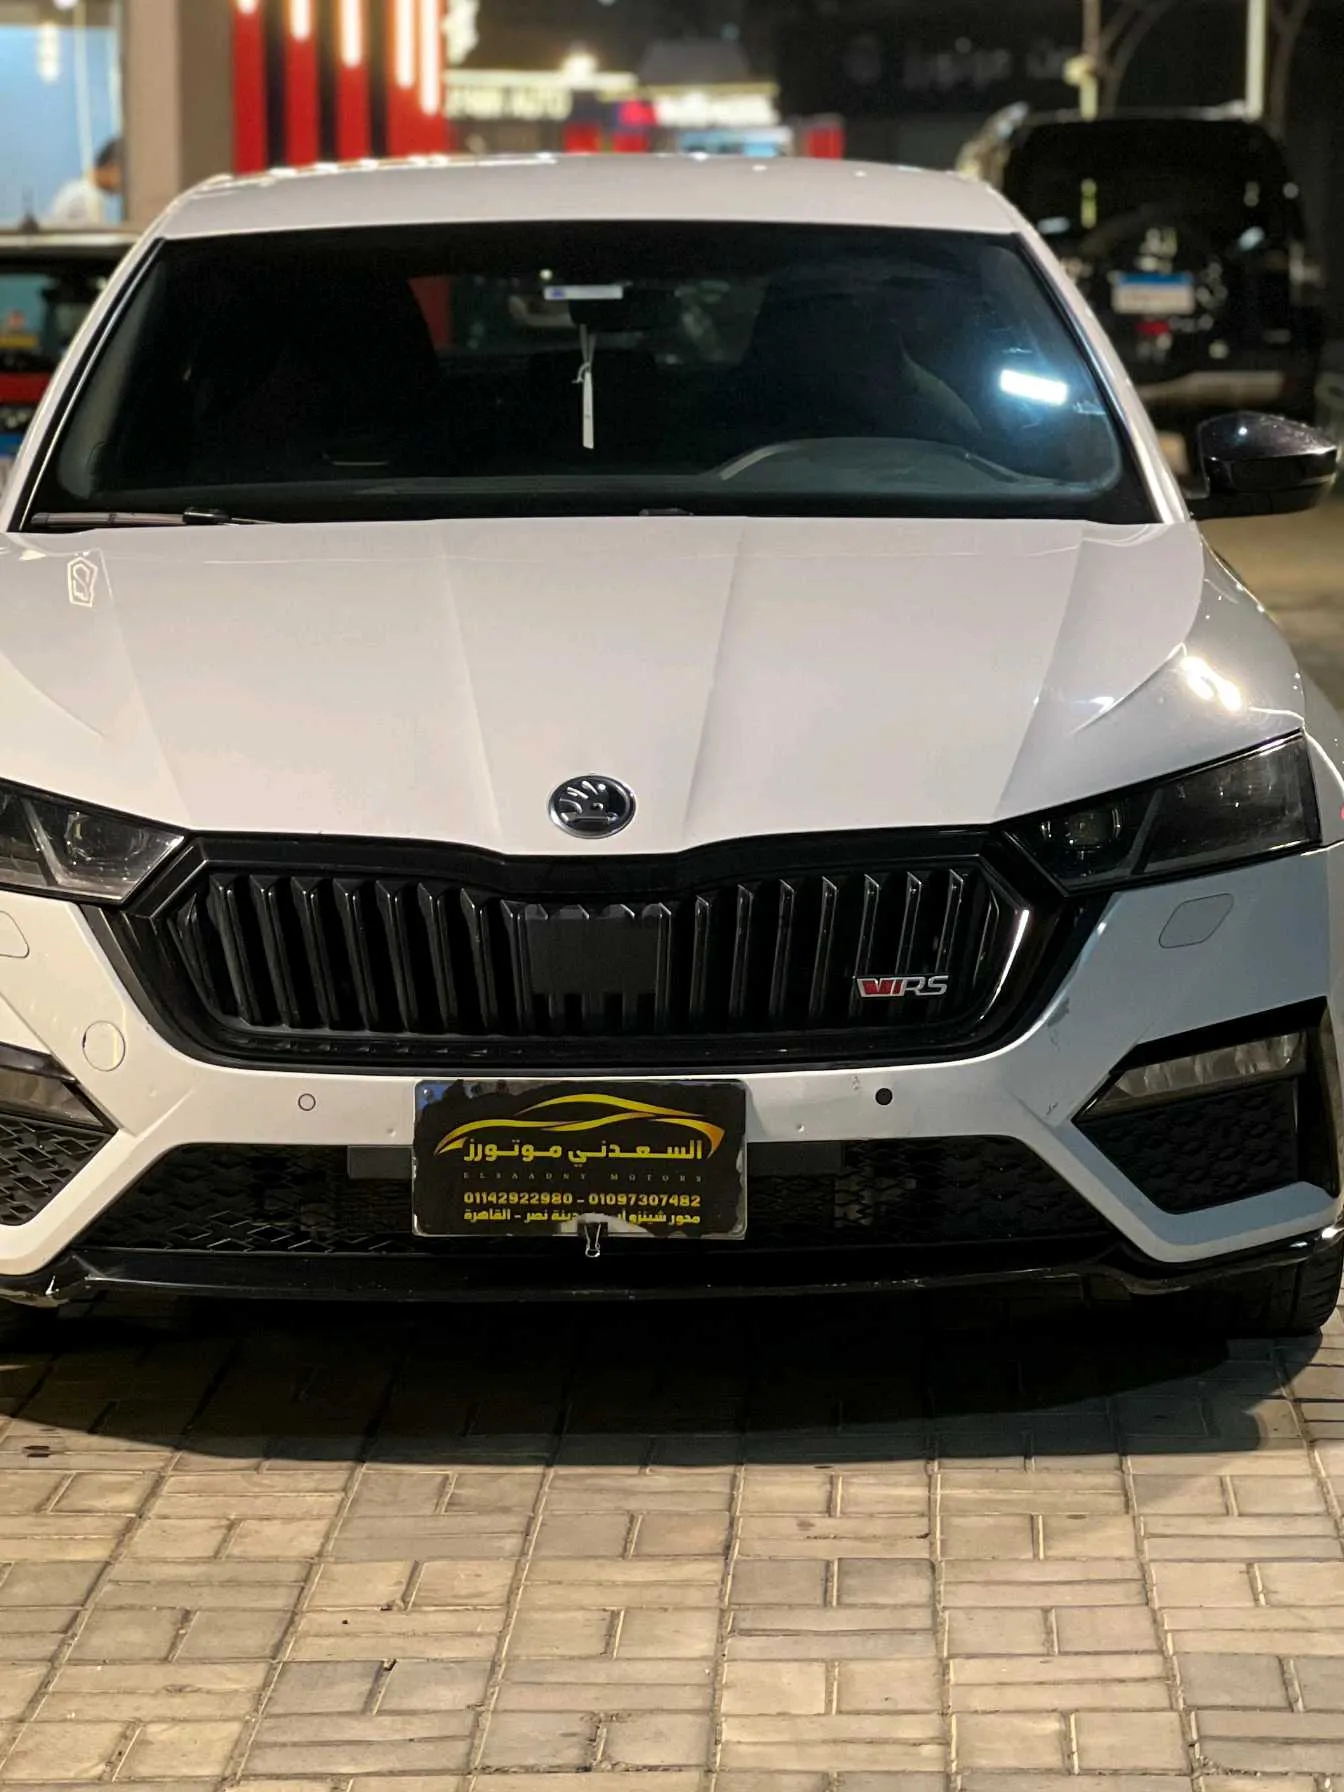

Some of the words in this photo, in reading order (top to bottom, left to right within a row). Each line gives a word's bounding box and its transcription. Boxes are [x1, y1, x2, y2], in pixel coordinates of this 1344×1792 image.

[463, 1138, 562, 1162] موتورز
[567, 1139, 702, 1168] السعدني
[463, 1191, 573, 1205] 01142922980
[588, 1193, 701, 1207] 01097307482
[463, 1208, 511, 1224] القاهرة
[523, 1209, 549, 1224] نصر
[667, 1213, 701, 1226] محور
